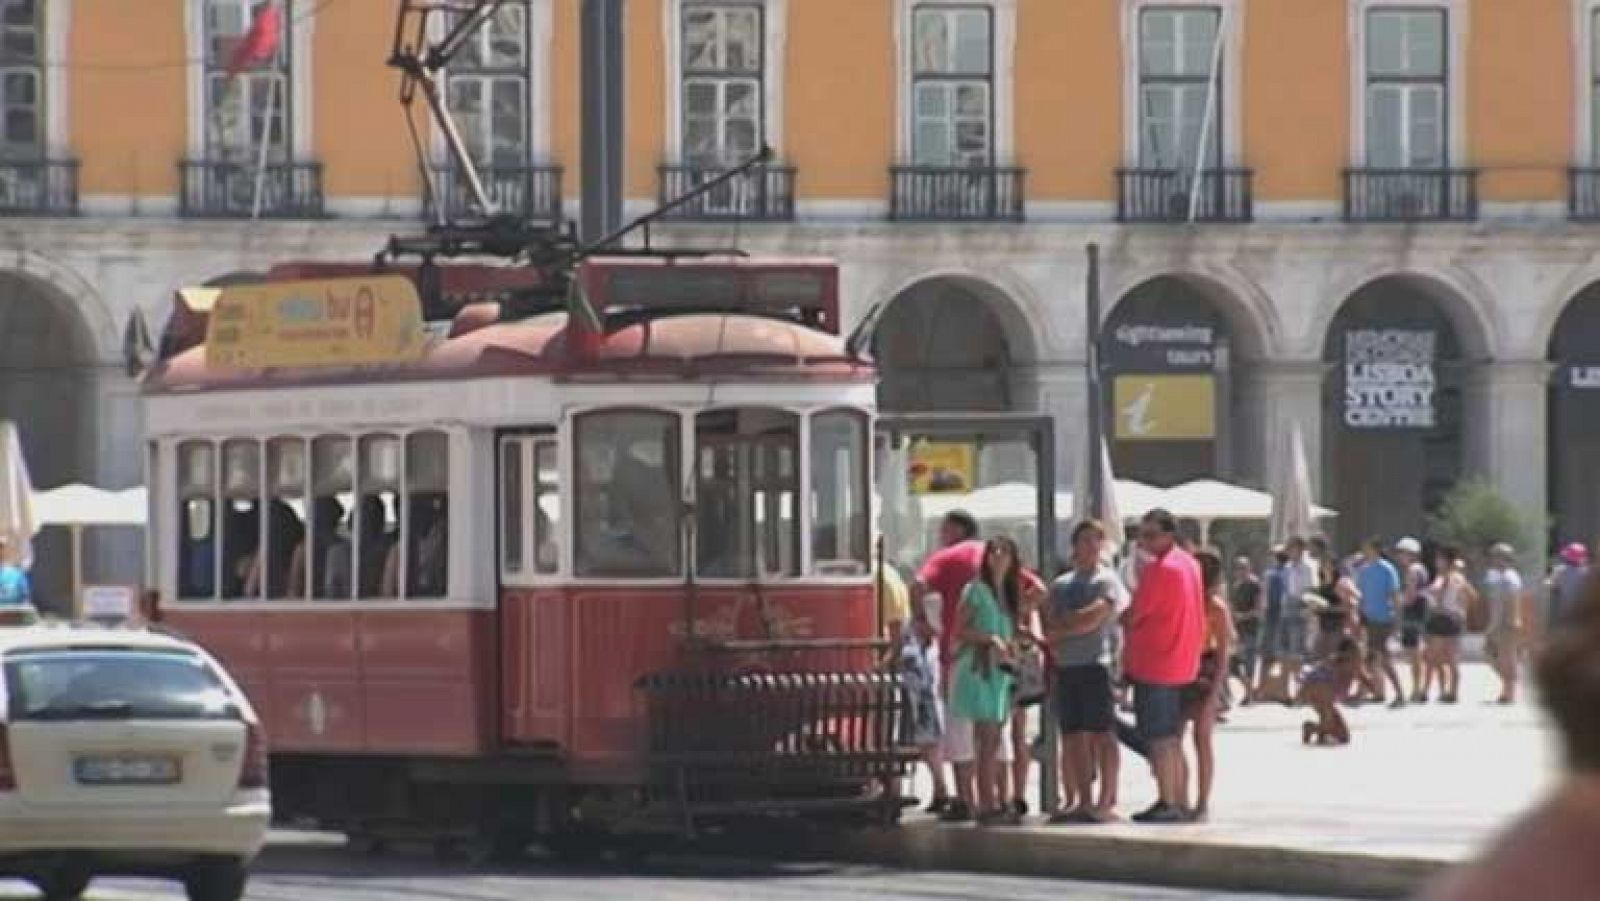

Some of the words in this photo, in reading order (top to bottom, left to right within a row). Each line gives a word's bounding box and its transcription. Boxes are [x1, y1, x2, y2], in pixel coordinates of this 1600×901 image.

[1346, 363, 1433, 383] LISBOA
[1345, 384, 1434, 407] STORY
[1345, 406, 1435, 427] CENTRE
